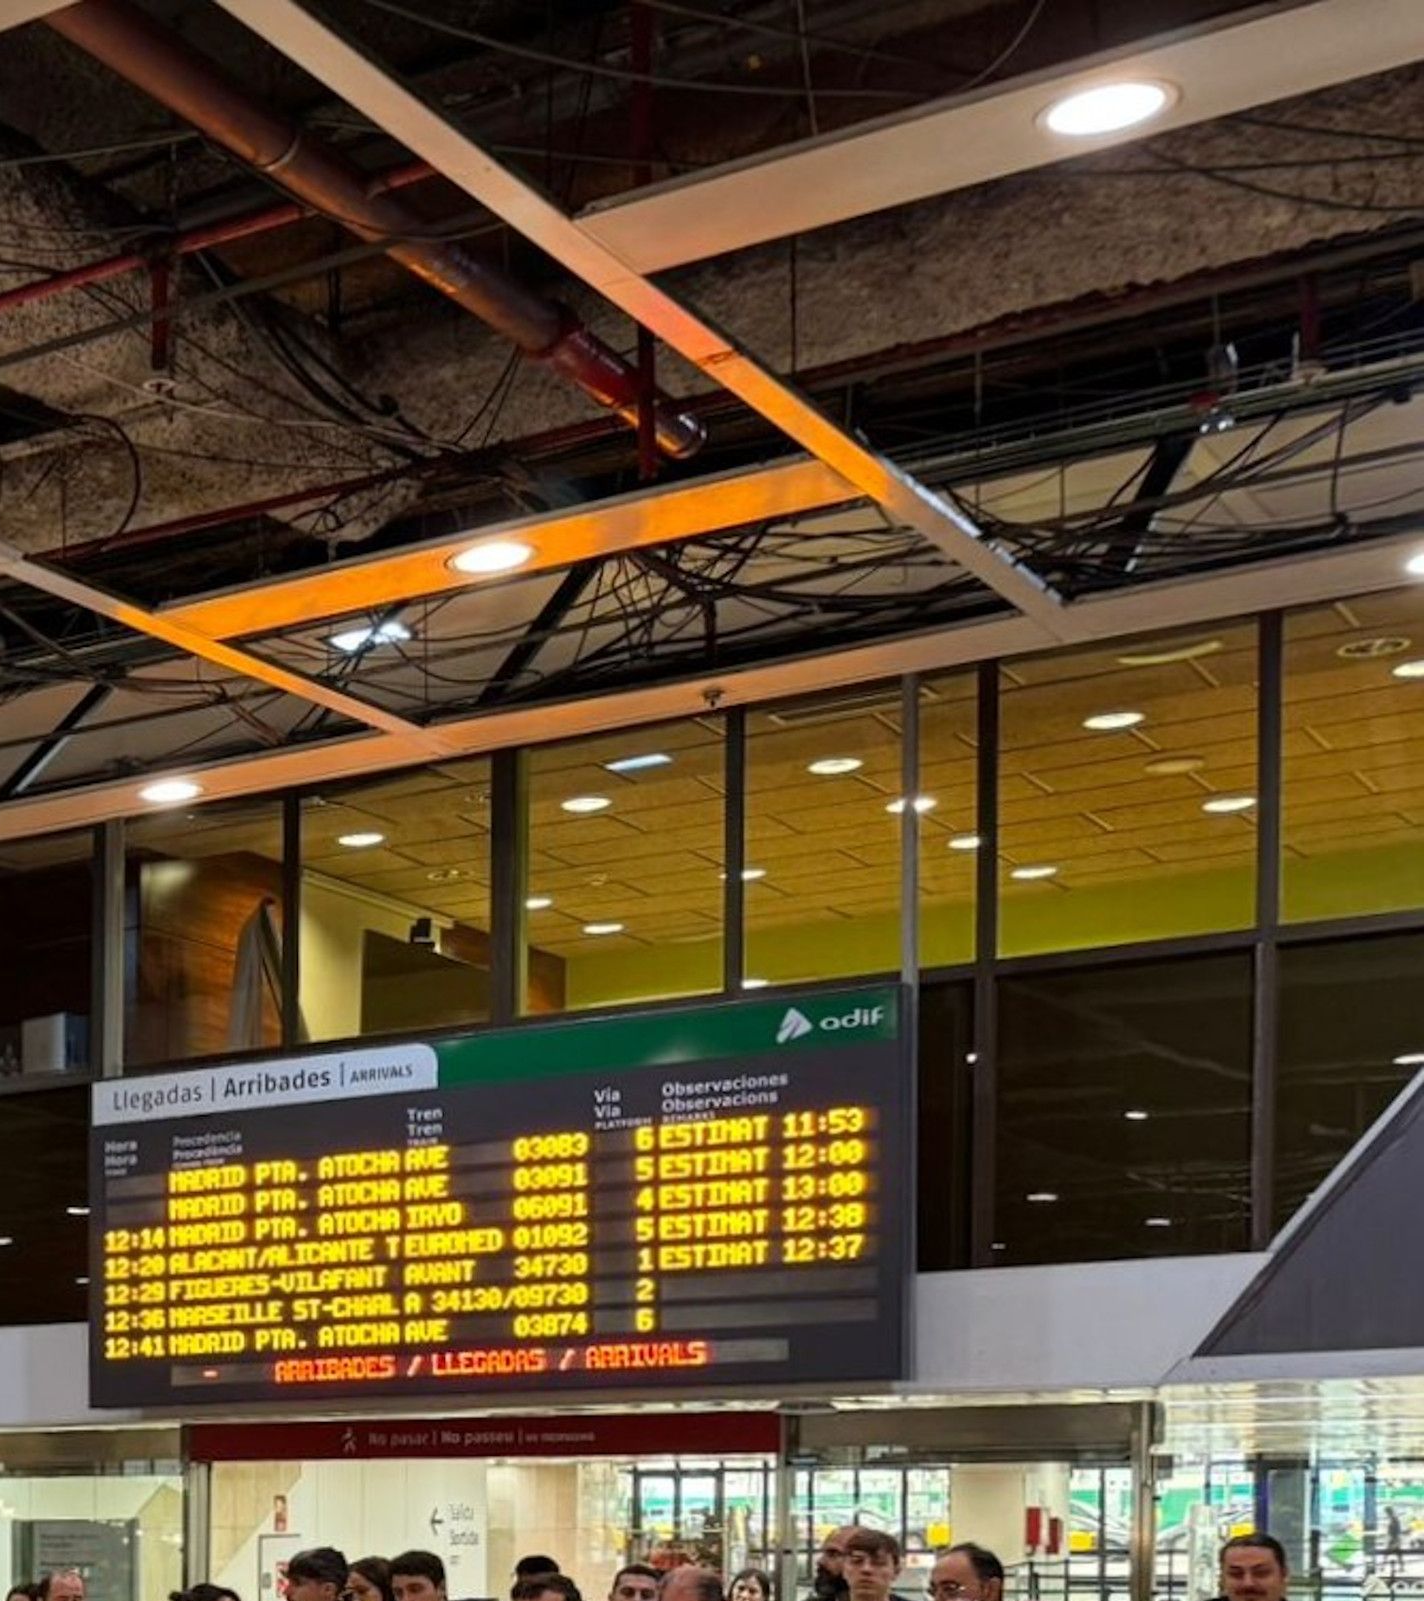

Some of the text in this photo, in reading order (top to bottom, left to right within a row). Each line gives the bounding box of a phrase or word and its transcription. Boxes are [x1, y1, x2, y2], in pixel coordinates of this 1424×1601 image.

[820, 1006, 884, 1031] adif
[112, 1064, 413, 1111] Llegadas Arribades ARRIVALS
[662, 1073, 788, 1098] Observaciones
[662, 1090, 778, 1114] Observacions
[407, 1107, 443, 1122] Tren
[407, 1122, 443, 1138] Tren
[168, 1166, 246, 1193] MADRID
[254, 1160, 308, 1186] PTA.
[318, 1151, 401, 1180] ATOCHA
[405, 1146, 449, 1171] AVE
[513, 1132, 589, 1162] 03083
[635, 1126, 654, 1151] 6
[659, 1116, 770, 1149] ESTIMAT
[782, 1107, 865, 1139] 11:53
[168, 1139, 865, 1221] MADRID PTA. ATOCHA AVE 03091 5 ESTIMAT 12:00
[104, 1227, 166, 1254] 12:14
[168, 1221, 246, 1248] MADRID
[254, 1217, 308, 1241] PTA.
[318, 1208, 401, 1237] ATOCHA
[513, 1192, 589, 1220] 06091
[636, 1186, 654, 1212] 4
[659, 1177, 770, 1211] ESTIMAT
[782, 1170, 865, 1202] 13:00
[104, 1203, 865, 1280] 12:20 ALACANT/ALICANTE T EUROMED 01092 5 ESTIMAT 12:38
[104, 1234, 864, 1308] 12:29 FIGUERES-VILAFANT AVANT 34730 1 ESTIMAT 12:37
[104, 1278, 654, 1333] 12:36 MARSEILLE ST-CHARL A 34130/09730 2
[104, 1307, 654, 1360] 12:41 MADRID PTA. ATOCHA AVE 03874 6
[274, 1355, 396, 1383] ARRIBADES
[432, 1348, 546, 1375] LLEGADAS
[585, 1341, 708, 1370] ARRIVALS
